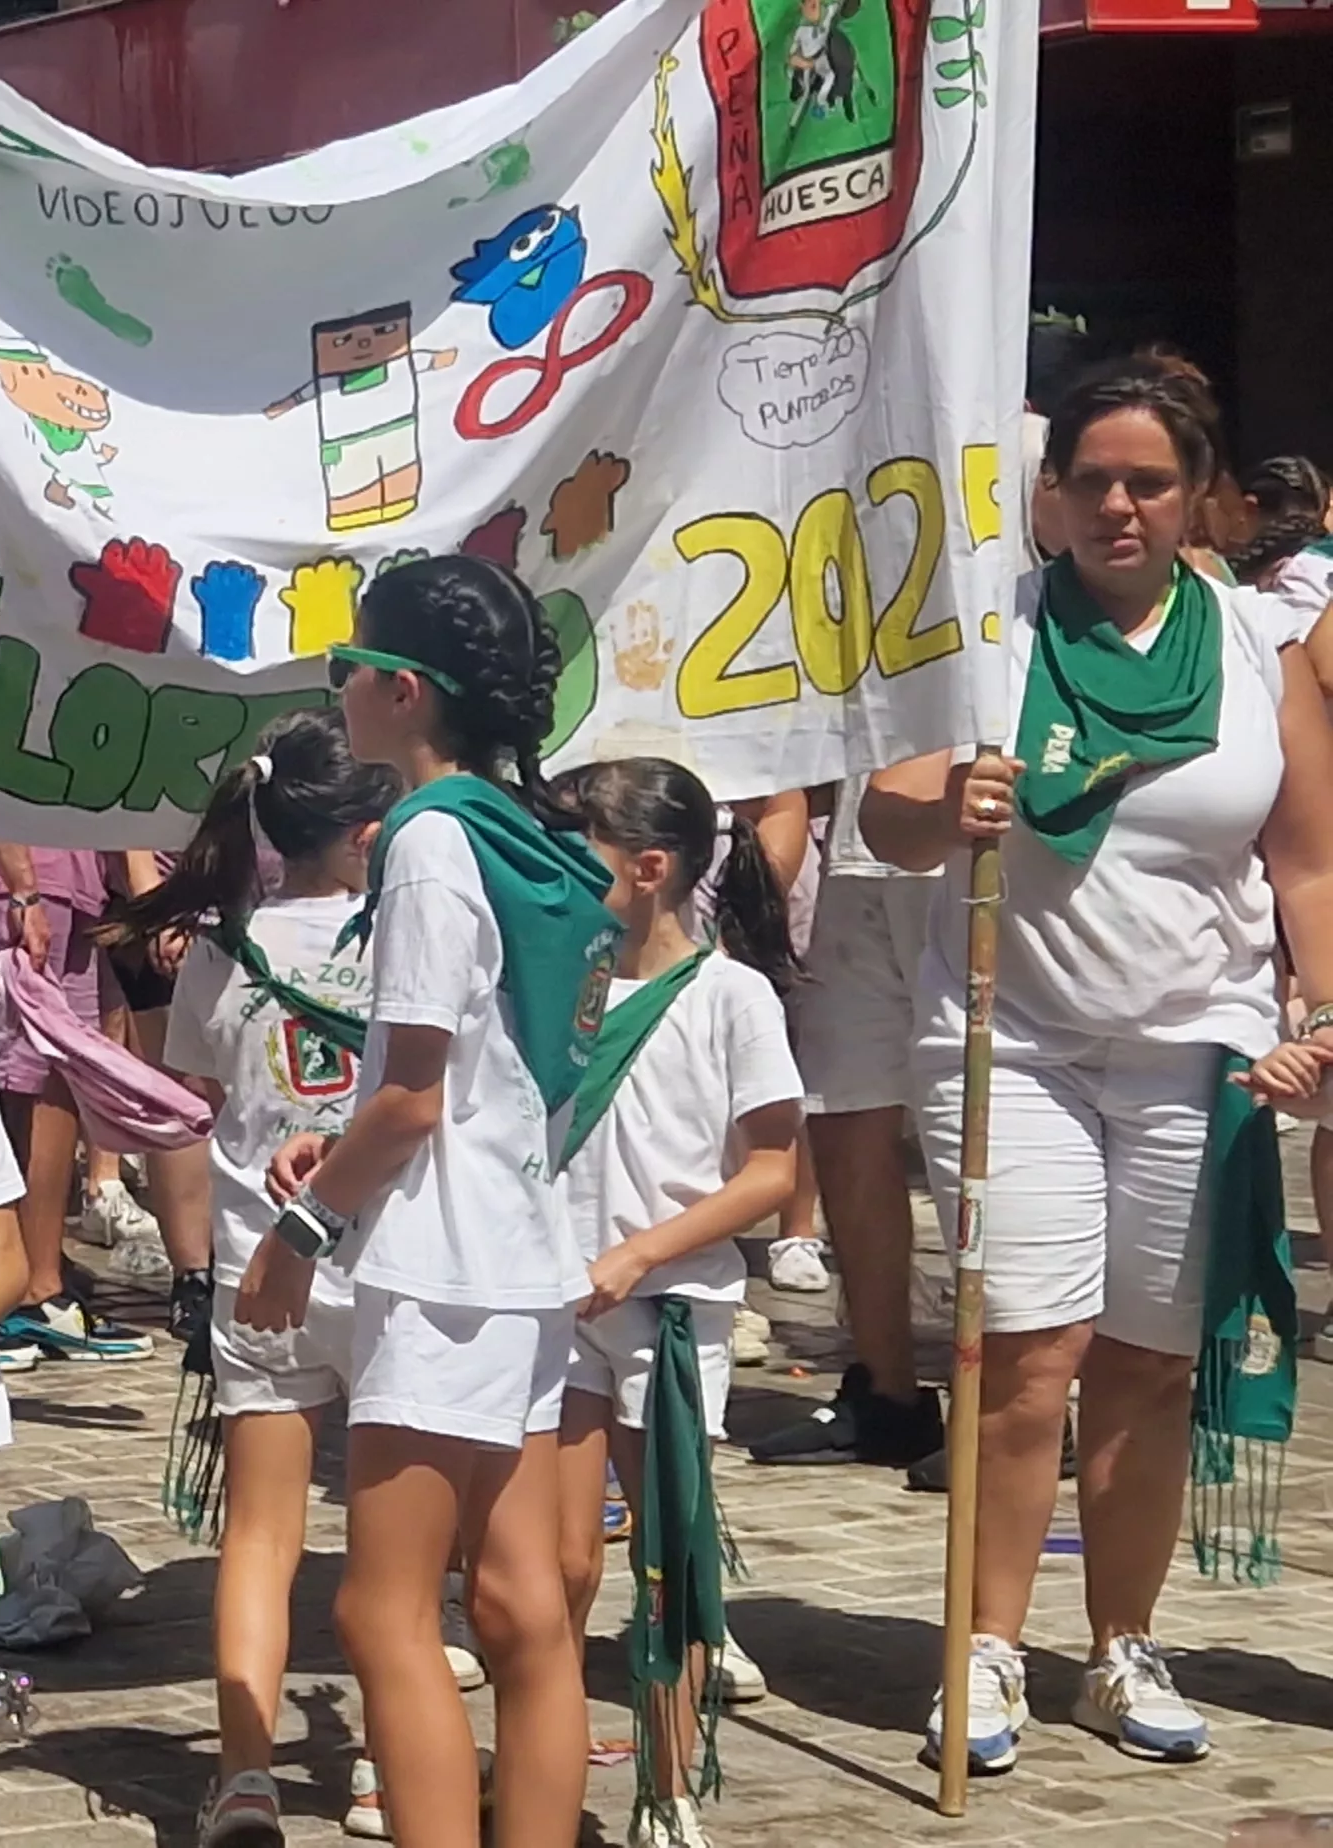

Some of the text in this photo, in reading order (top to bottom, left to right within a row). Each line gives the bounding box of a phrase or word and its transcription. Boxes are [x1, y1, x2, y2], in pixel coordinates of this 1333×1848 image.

[716, 27, 753, 221] PEÑA
[763, 163, 886, 224] HUESCA
[239, 963, 374, 1024] PEA ZOI
